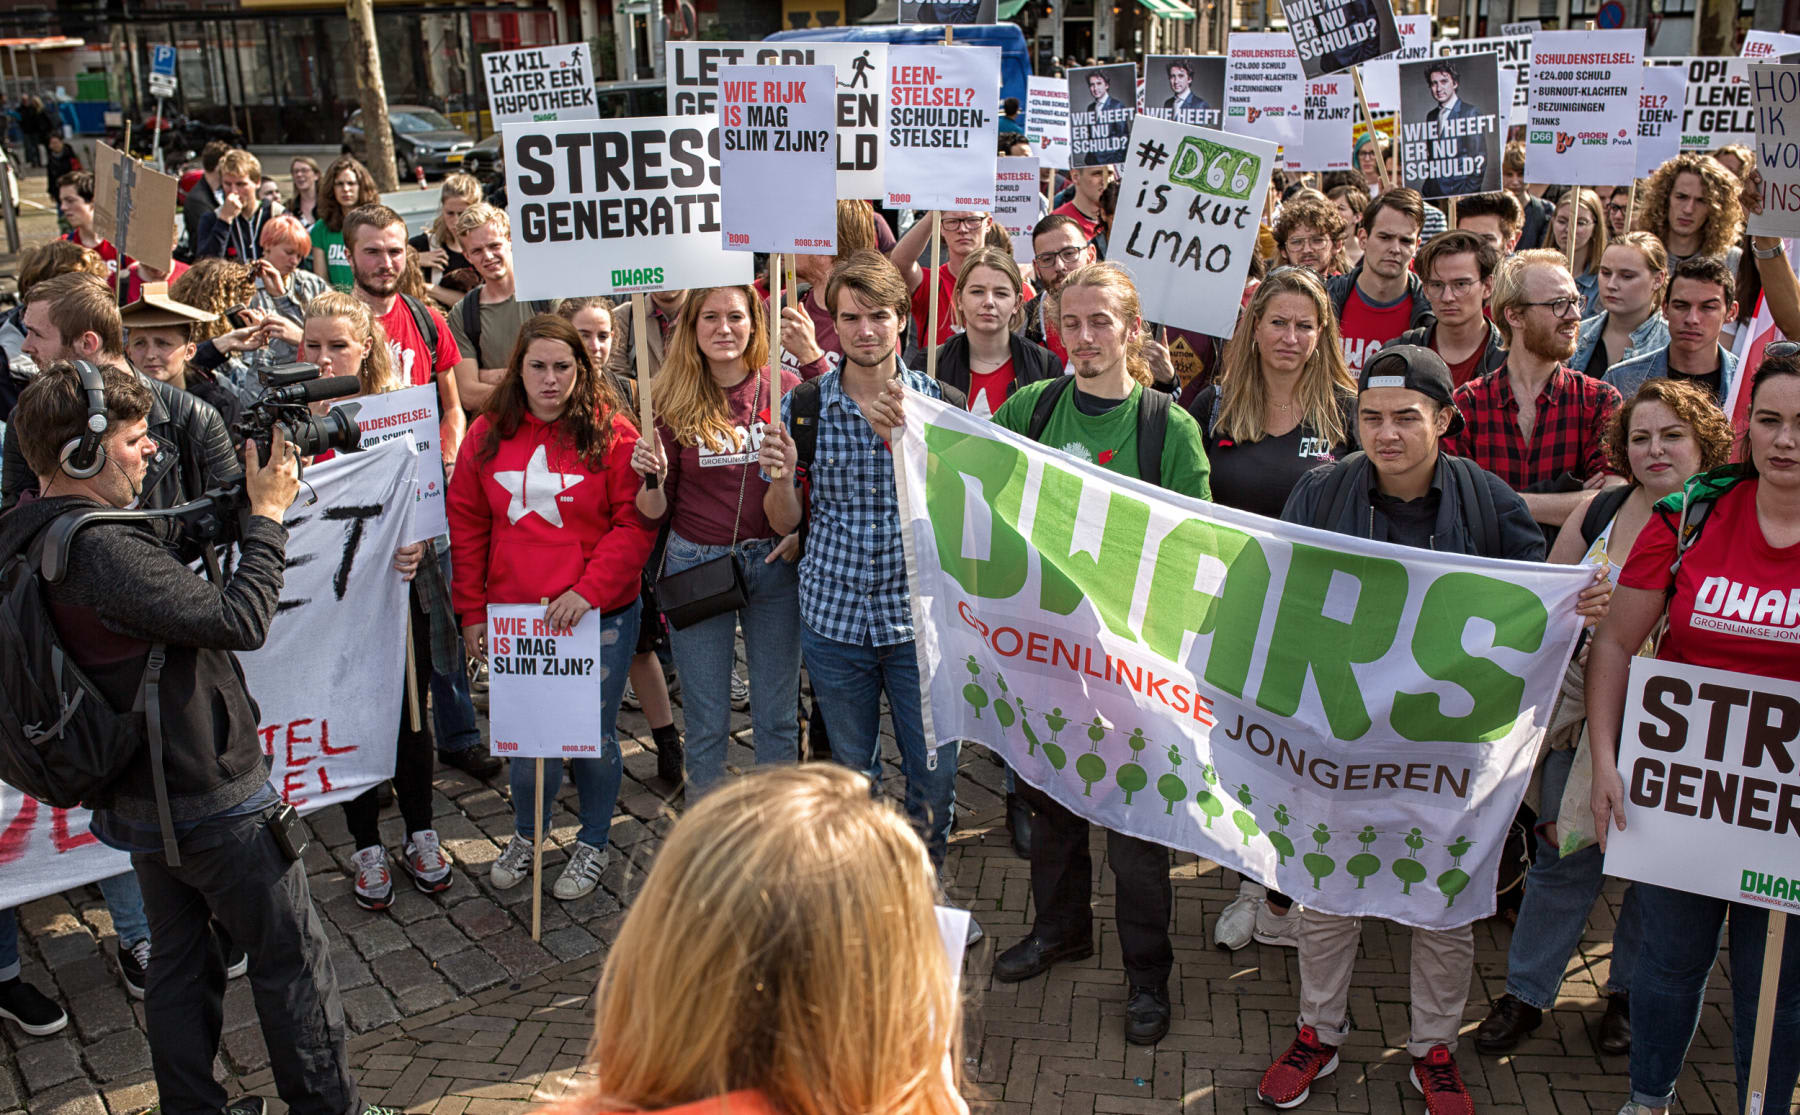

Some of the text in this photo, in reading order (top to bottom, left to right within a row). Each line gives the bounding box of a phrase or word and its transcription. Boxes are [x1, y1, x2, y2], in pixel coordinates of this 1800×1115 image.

[1286, 0, 1323, 22] WIE
[1292, 8, 1347, 42] ER NU
[1298, 18, 1377, 61] SCHULD?
[1745, 41, 1775, 55] LEEN-
[158, 47, 171, 62] P
[488, 51, 550, 74] IK WIL
[1231, 49, 1296, 58] SCHULDENSTELSE
[1535, 53, 1636, 65] SCHULDENSTELSEL:
[491, 68, 584, 95] LATER EEN
[892, 66, 943, 85] LEEN-
[1539, 71, 1574, 80] €24.000
[1576, 70, 1611, 81] SCHULD
[1688, 60, 1728, 83] OP!
[723, 81, 807, 104] WIE RIJK
[1312, 83, 1338, 96] RIJK
[1538, 86, 1628, 96] BURNOUT-KLACHTEN
[1695, 86, 1754, 106] LENE
[1754, 70, 1800, 103] HO
[494, 88, 594, 115] HYPOTHEEK
[891, 87, 975, 107] STELSEL?
[1304, 96, 1327, 107] MAG
[1538, 102, 1605, 112] BEZUINIGINGEN
[723, 105, 788, 128] IS MAG
[890, 108, 990, 128] SCHULDEN-
[1071, 107, 1135, 126] WIE HEEFT
[1145, 107, 1221, 124] WIE HEEFT
[1317, 107, 1351, 120] ZIJN?
[1531, 117, 1561, 126] THANKS
[1760, 106, 1785, 136] IK
[1072, 125, 1109, 140] ER NU
[1403, 121, 1439, 142] WIE
[1443, 114, 1496, 138] HEEFT
[725, 129, 829, 152] SLIM ZIJN?
[889, 129, 969, 149] STELSEL!
[1073, 136, 1128, 154] SCHULD?
[1531, 132, 1552, 142] D66
[1556, 132, 1575, 153] VVD
[1404, 138, 1458, 161] ER NU
[1761, 142, 1800, 169] WO
[1405, 155, 1485, 181] SCHULD?
[995, 184, 1020, 192] SCHULD
[1136, 180, 1171, 214] is
[889, 194, 911, 203] ROOD
[729, 233, 750, 244] ROOD
[1126, 221, 1231, 273] LMAO
[611, 267, 664, 286] DWARS
[358, 407, 432, 433] ULDENSTELSEL:
[925, 423, 1549, 744] DWARS
[493, 617, 527, 636] WIE
[1693, 617, 1800, 641] GROENLINKSE JON
[493, 637, 556, 656] IS MAG
[494, 657, 594, 676] SLIM ZIJN?
[957, 600, 1471, 798] GROENLINKSE JONGEREN
[1638, 675, 1800, 775] STR
[497, 741, 518, 751] ROOD
[1740, 869, 1800, 903] DWAR
